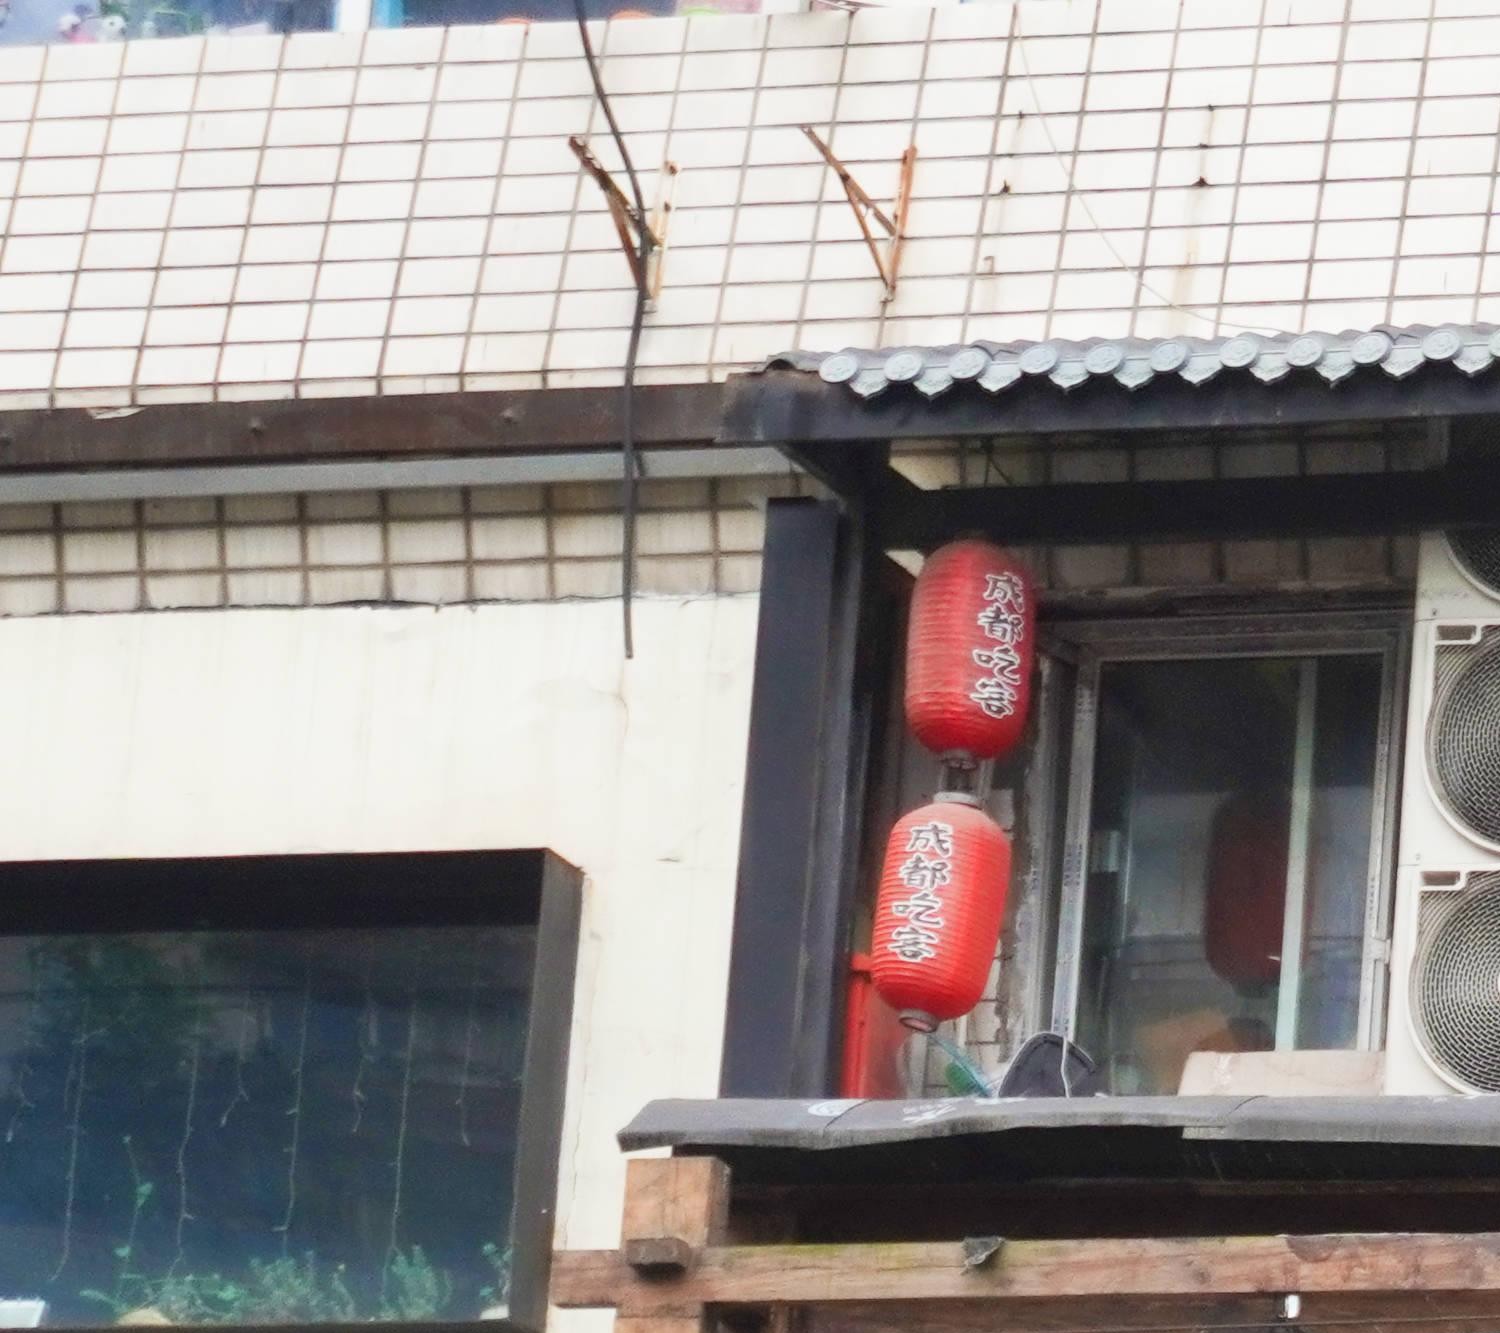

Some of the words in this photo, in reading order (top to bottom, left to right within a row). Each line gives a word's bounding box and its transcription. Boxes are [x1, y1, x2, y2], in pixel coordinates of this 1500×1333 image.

[969, 571, 1025, 719] 成都吃客
[889, 822, 953, 963] 成都吃客
